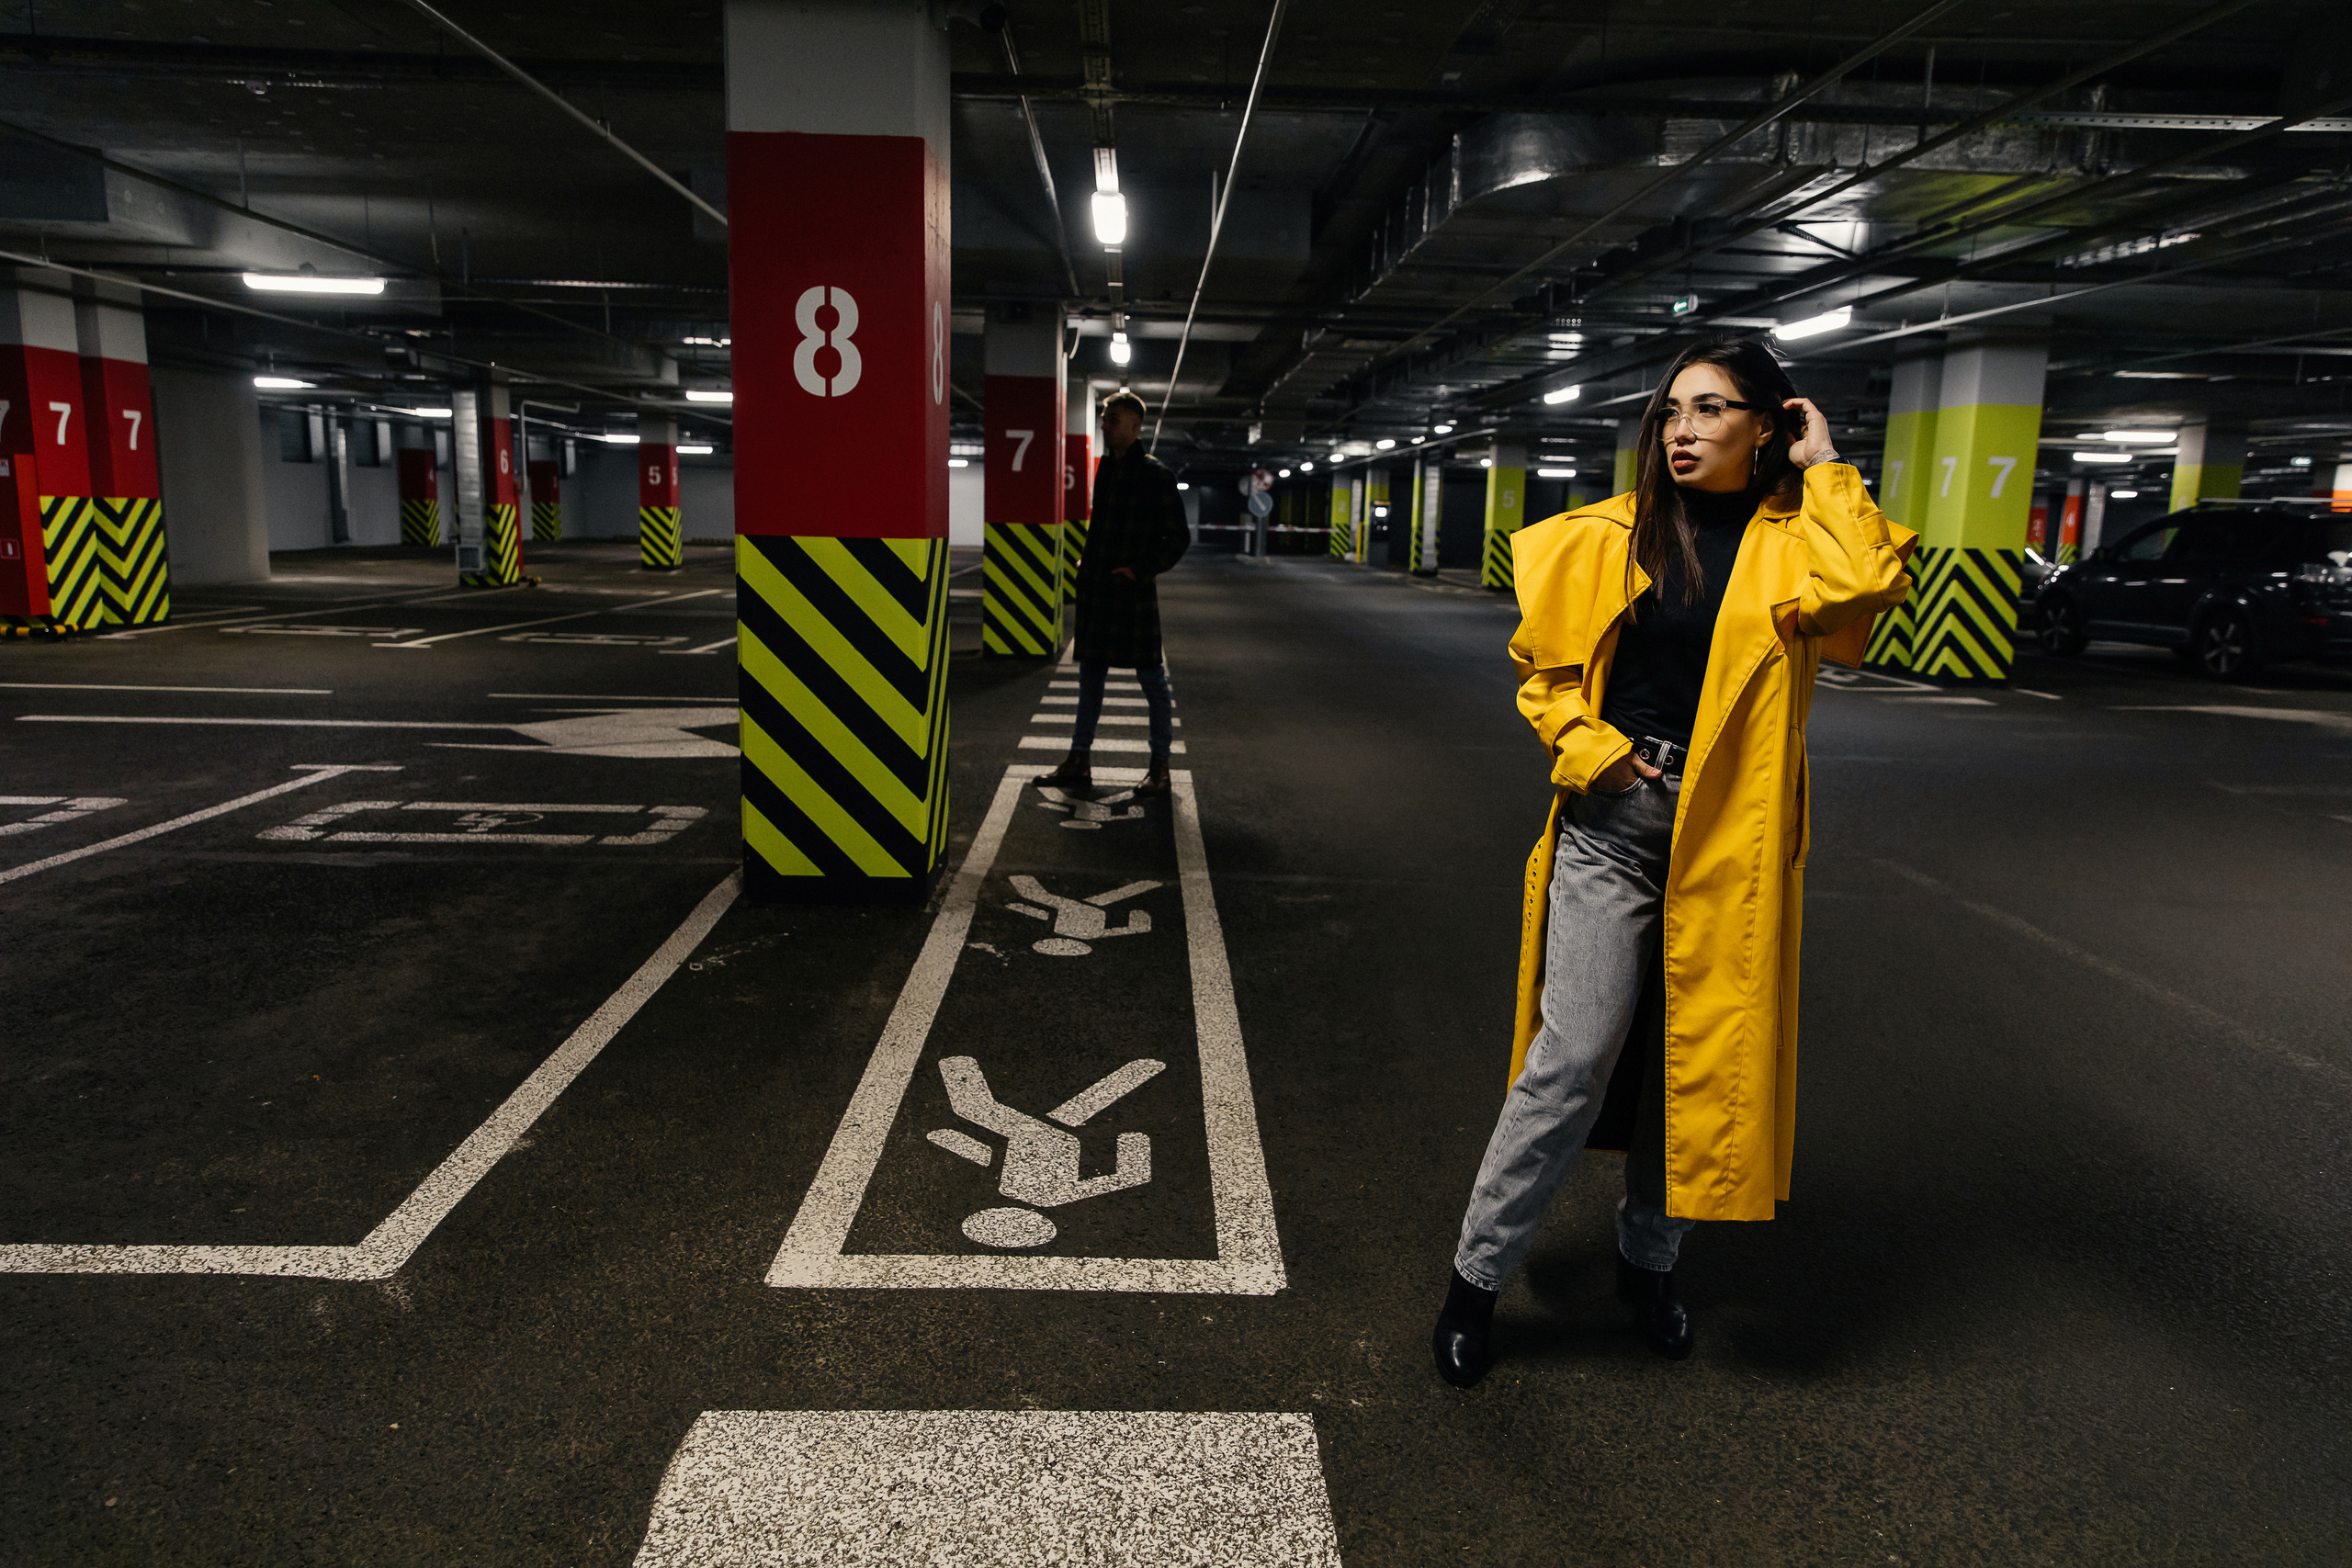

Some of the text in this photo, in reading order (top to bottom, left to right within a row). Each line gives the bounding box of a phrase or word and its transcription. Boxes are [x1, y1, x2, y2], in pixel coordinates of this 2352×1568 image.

[793, 286, 862, 397] 8
[49, 400, 72, 446] 7
[122, 409, 141, 450] 7
[500, 449, 509, 475] 6
[1005, 429, 1035, 472] 7
[649, 465, 662, 485] 5
[1889, 460, 1903, 499] 7
[1941, 457, 1957, 498] 7
[1988, 457, 2017, 498] 7
[1502, 490, 1515, 508] 5
